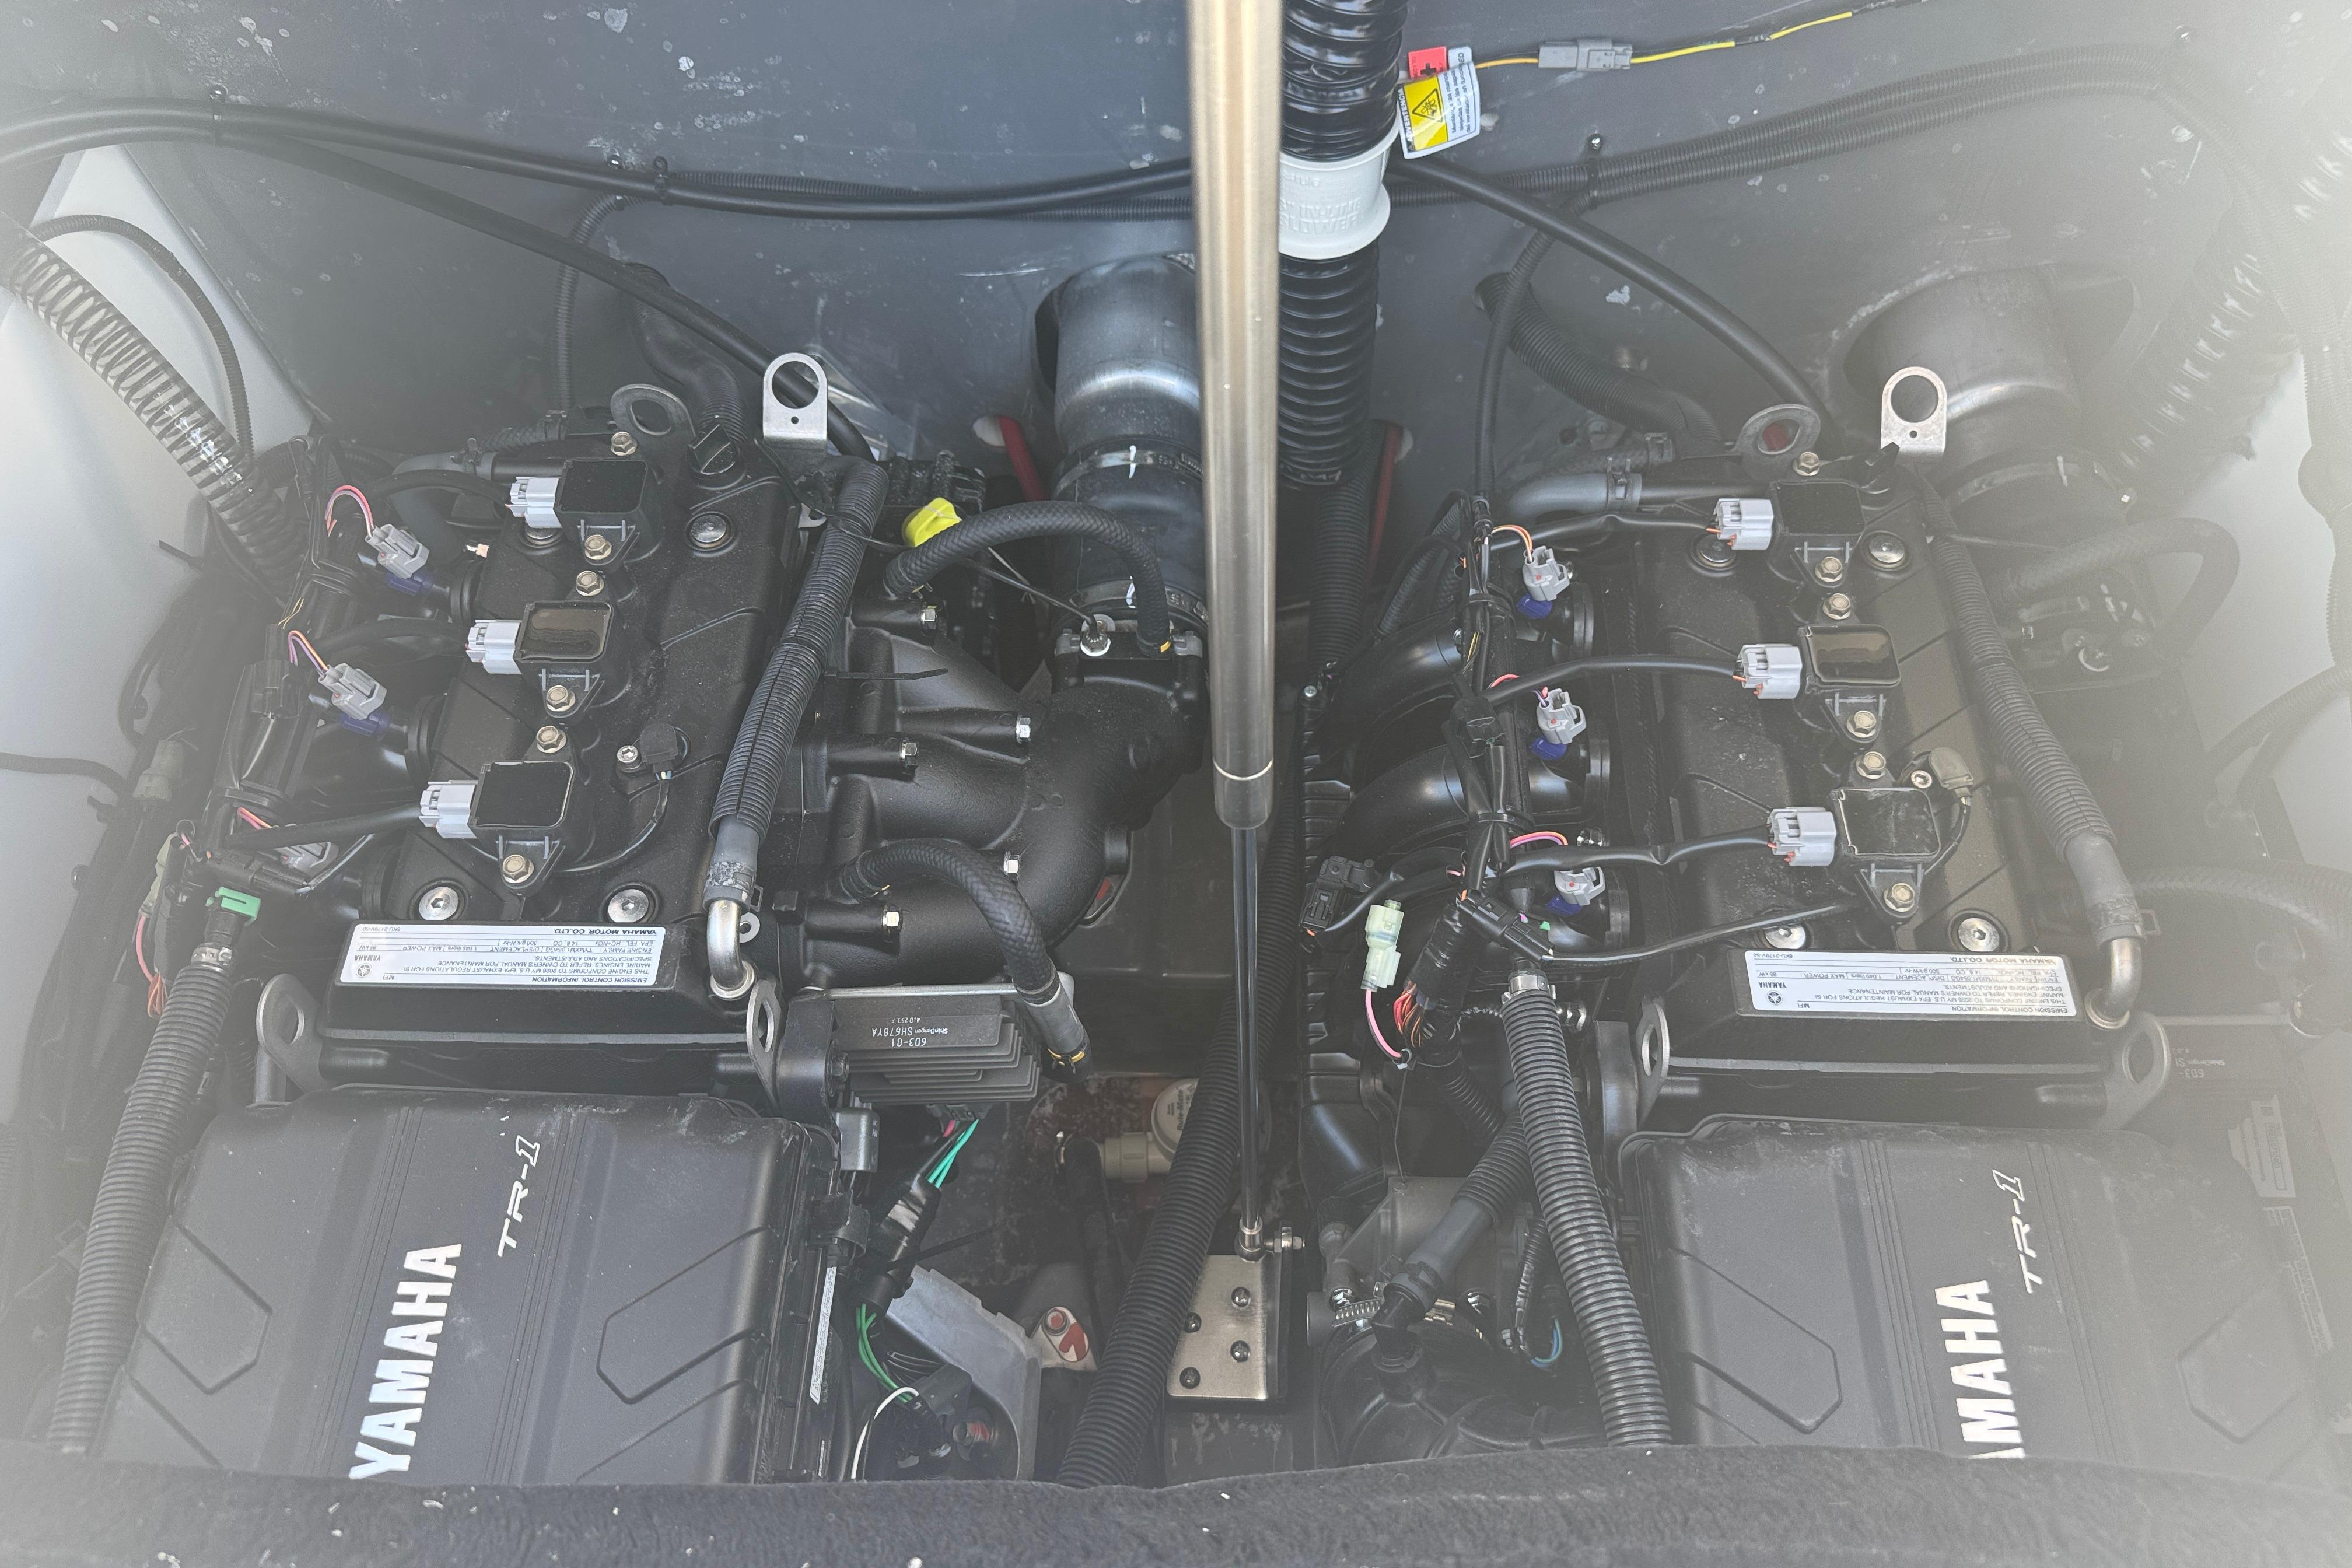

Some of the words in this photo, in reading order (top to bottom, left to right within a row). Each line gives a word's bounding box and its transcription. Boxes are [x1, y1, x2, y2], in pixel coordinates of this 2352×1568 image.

[872, 1027, 913, 1035] SH678YA
[2179, 1068, 2204, 1078] 6D3-
[348, 1244, 463, 1479] YAMAHA
[1934, 1280, 2025, 1459] MAHA
